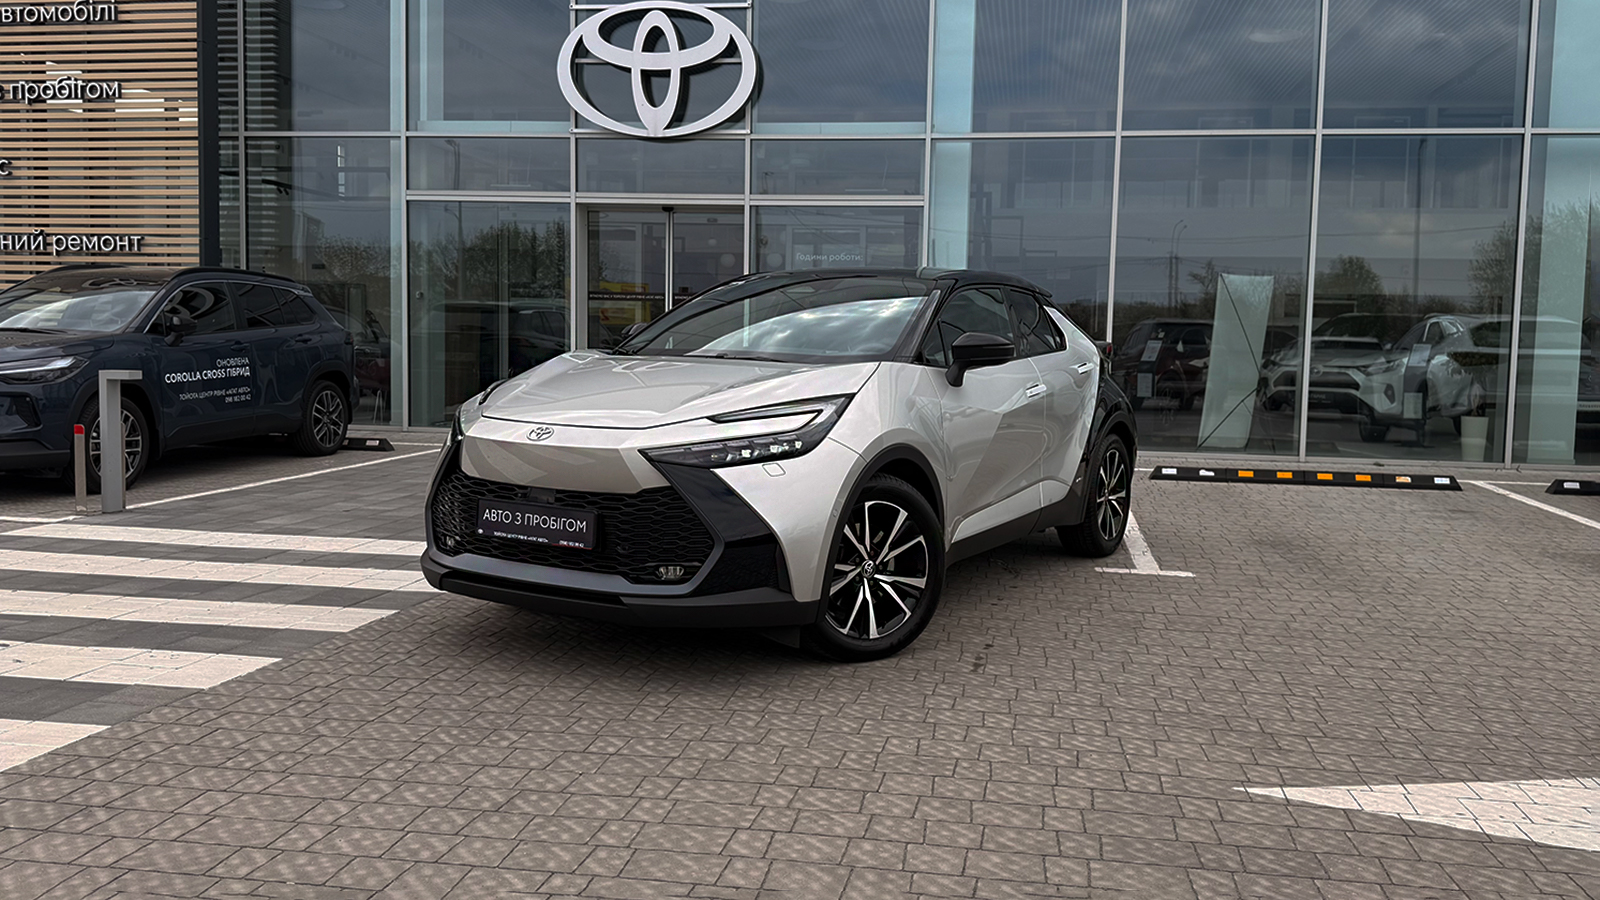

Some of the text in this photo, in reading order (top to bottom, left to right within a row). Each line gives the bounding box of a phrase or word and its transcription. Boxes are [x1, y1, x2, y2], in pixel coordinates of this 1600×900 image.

[10, 76, 119, 104] пробігом
[53, 234, 142, 256] ремонт
[796, 252, 864, 262] Години роботи:
[216, 357, 250, 367] ОНОВЛЕНА
[165, 372, 202, 383] COROLLA
[202, 369, 226, 380] CROSS
[483, 509, 512, 524] АВТО
[524, 513, 587, 533] ПРОБІГОМ
